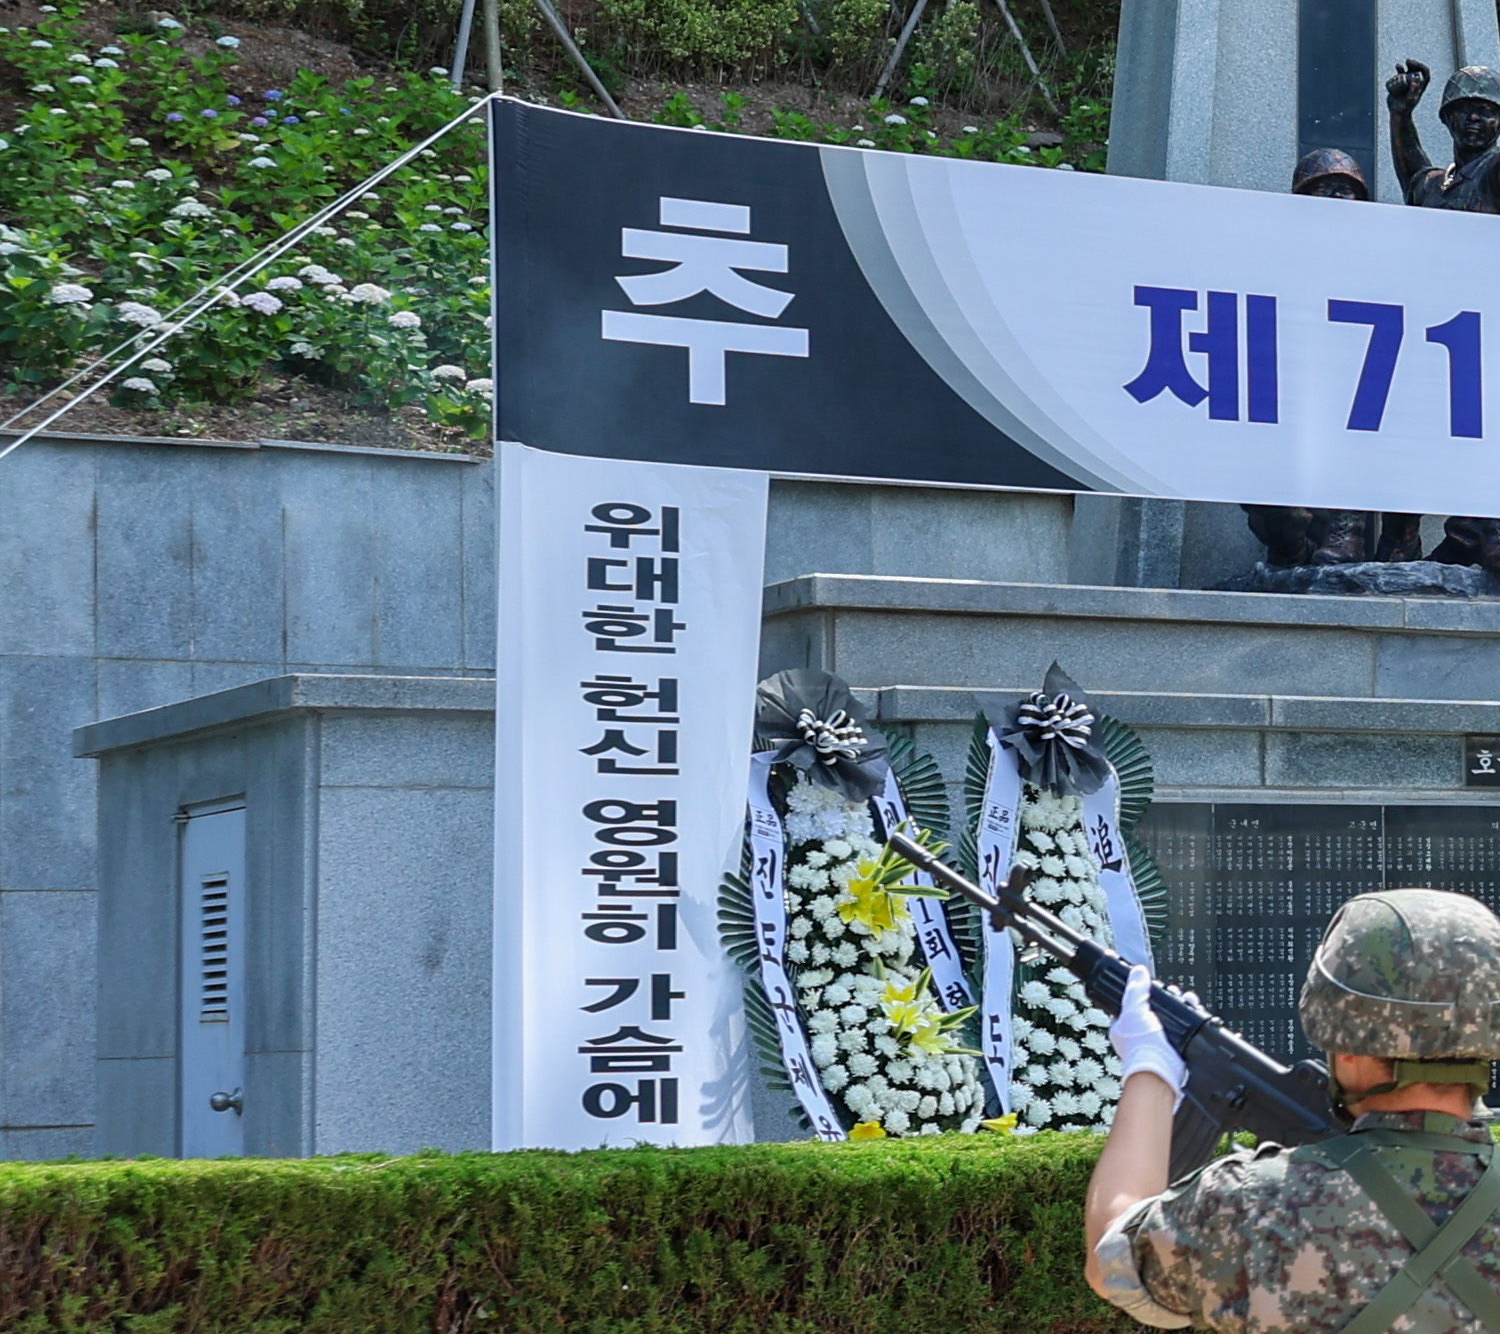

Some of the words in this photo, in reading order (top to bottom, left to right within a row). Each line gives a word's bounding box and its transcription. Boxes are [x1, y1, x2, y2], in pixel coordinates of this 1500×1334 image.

[602, 196, 809, 406] 추
[581, 501, 686, 655] 위대한
[578, 675, 681, 775] 헌신
[580, 798, 681, 951] 영원히
[1091, 813, 1122, 873] 追
[577, 973, 686, 1125] 가슴에
